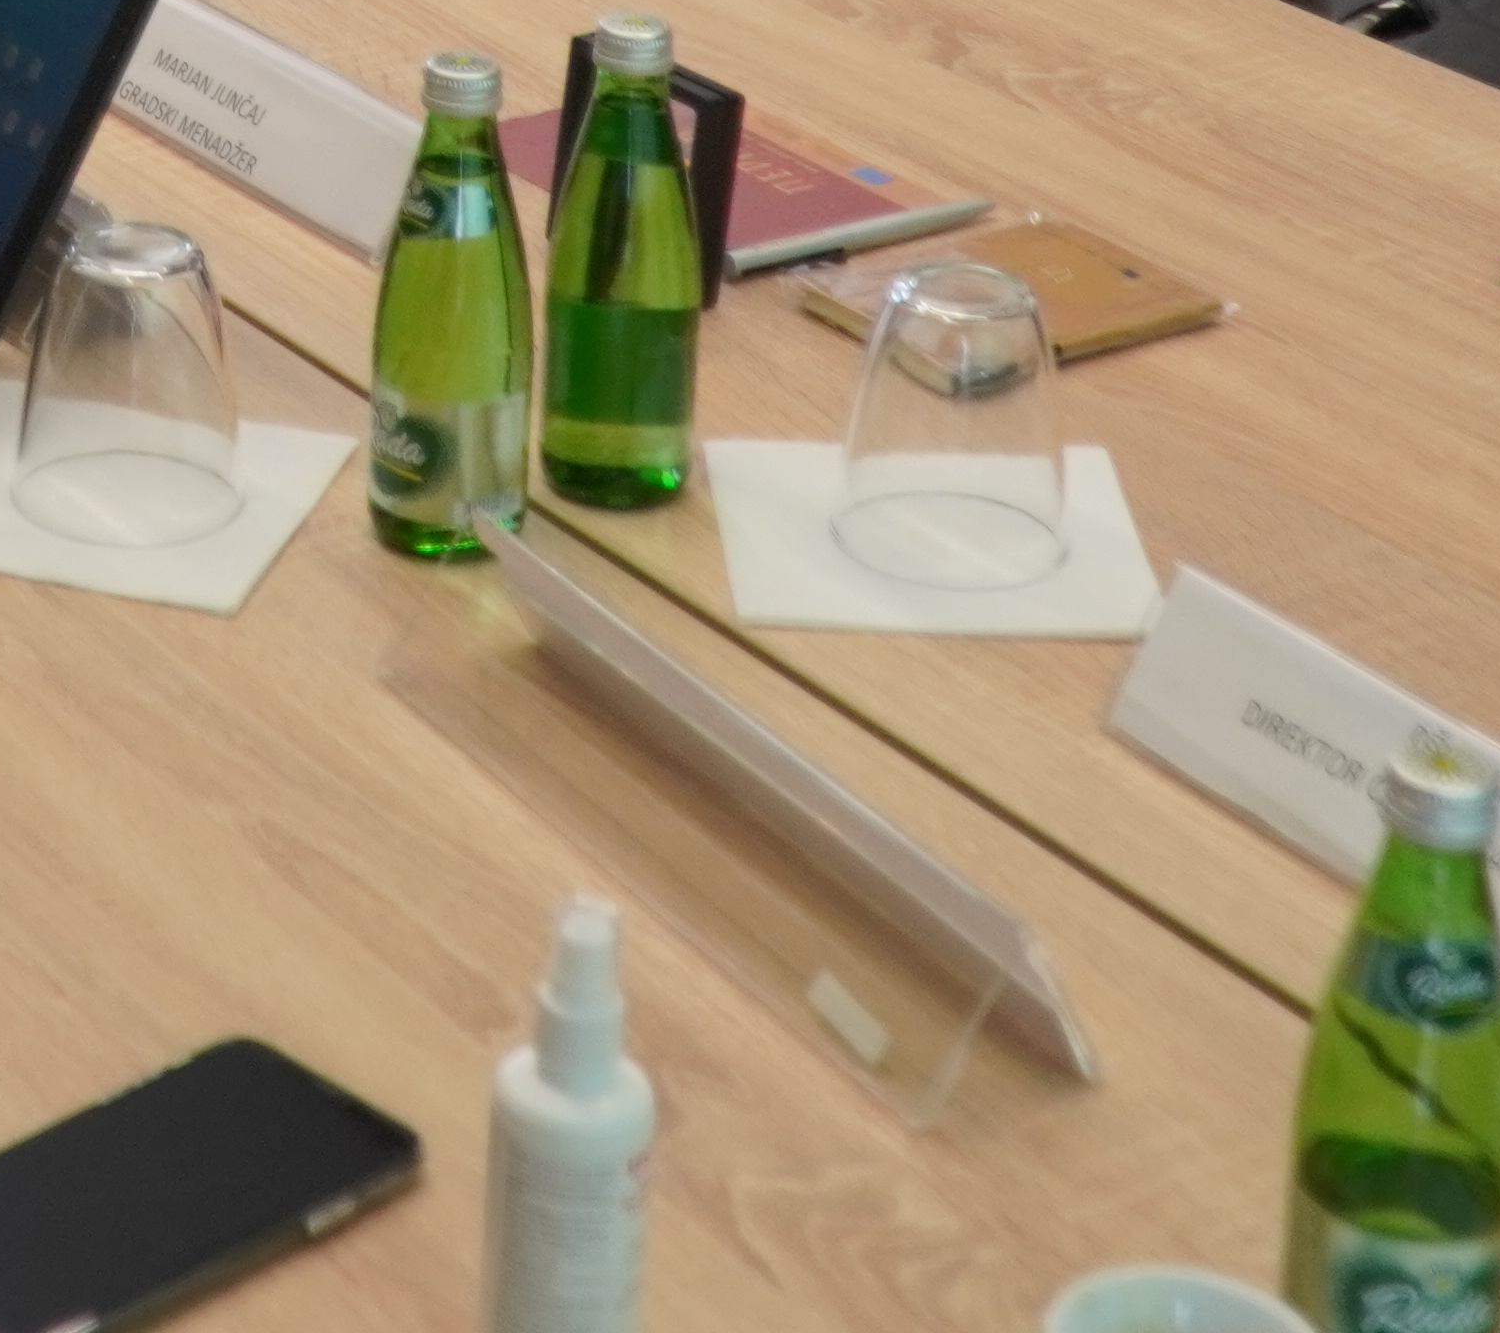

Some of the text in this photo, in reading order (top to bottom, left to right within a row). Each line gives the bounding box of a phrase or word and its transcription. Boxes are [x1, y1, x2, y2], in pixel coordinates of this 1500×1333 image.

[119, 80, 258, 176] GRADSKI MENADŽER
[153, 48, 266, 126] MARJAN JUNČAJ
[1240, 699, 1365, 786] DIREKTOR
